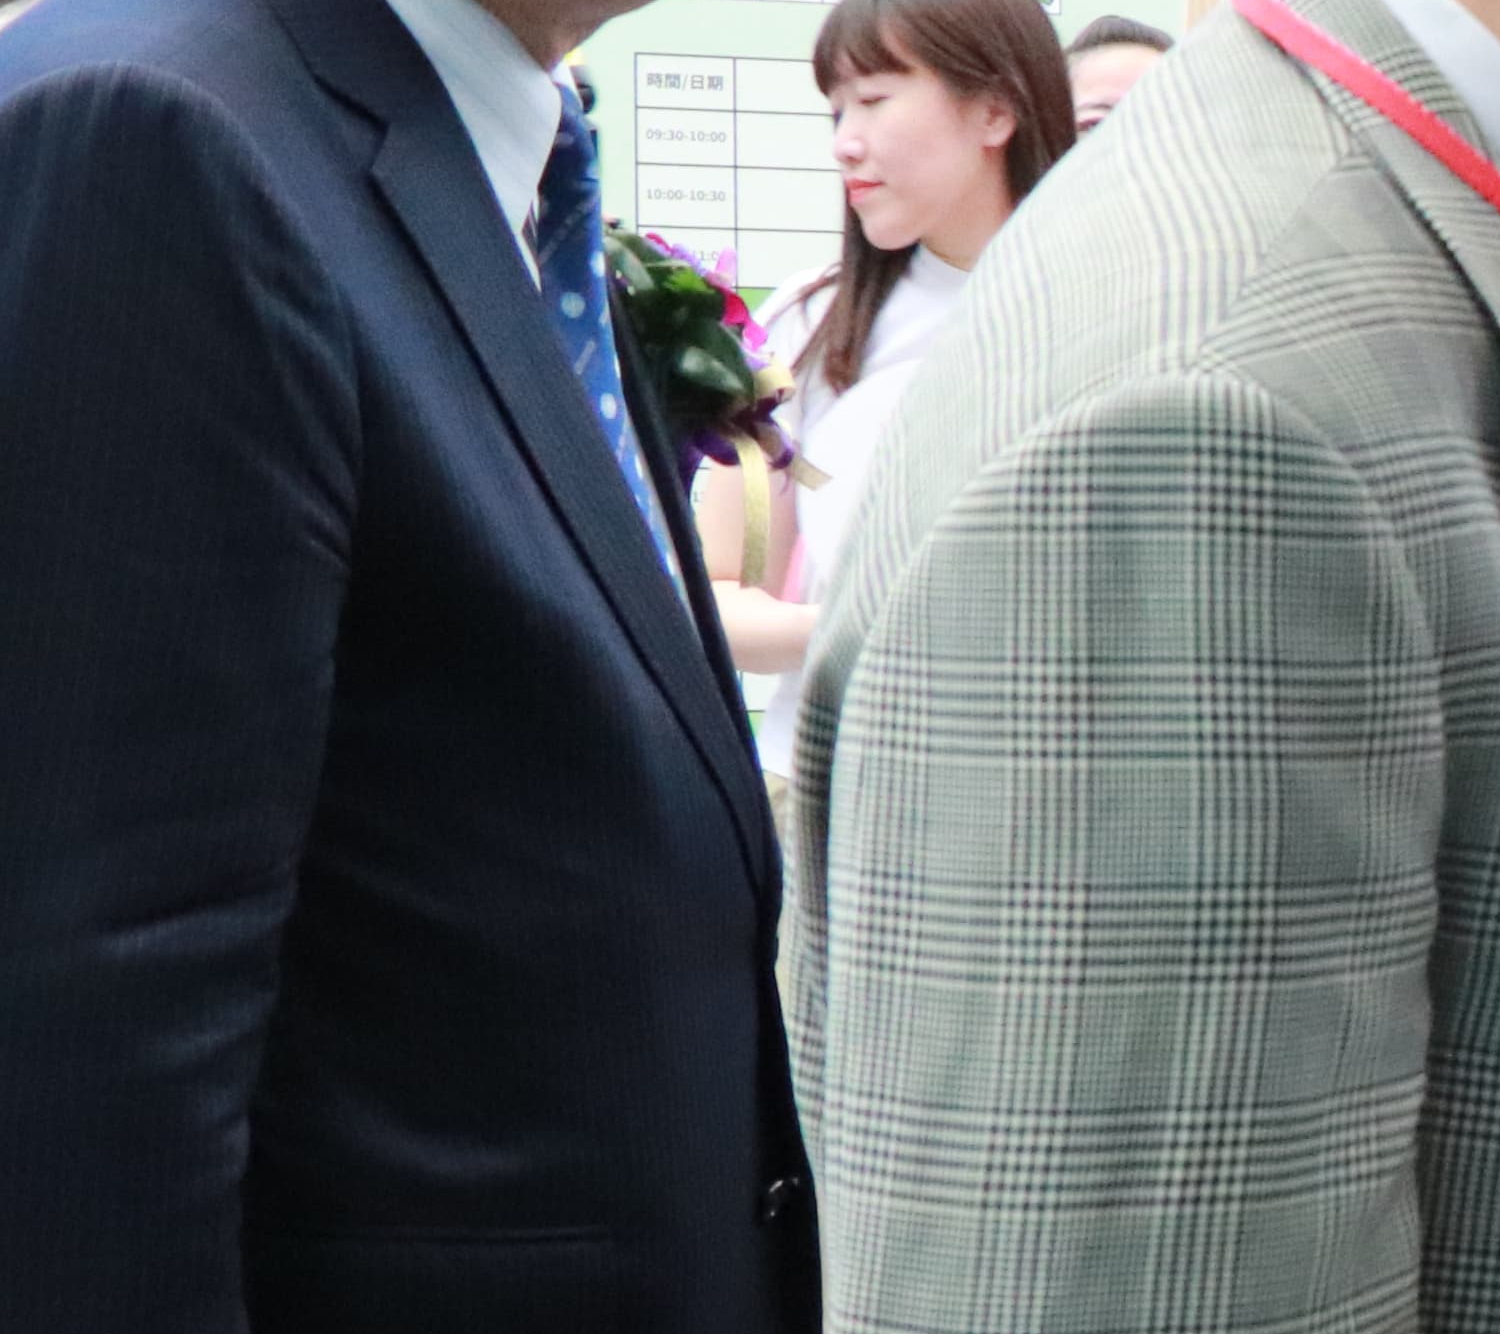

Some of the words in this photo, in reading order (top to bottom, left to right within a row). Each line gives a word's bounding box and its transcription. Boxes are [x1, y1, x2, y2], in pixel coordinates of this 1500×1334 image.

[646, 72, 724, 91] 時間/日期
[645, 128, 726, 144] 09:30-10:00
[646, 188, 726, 203] 10:00-10:30
